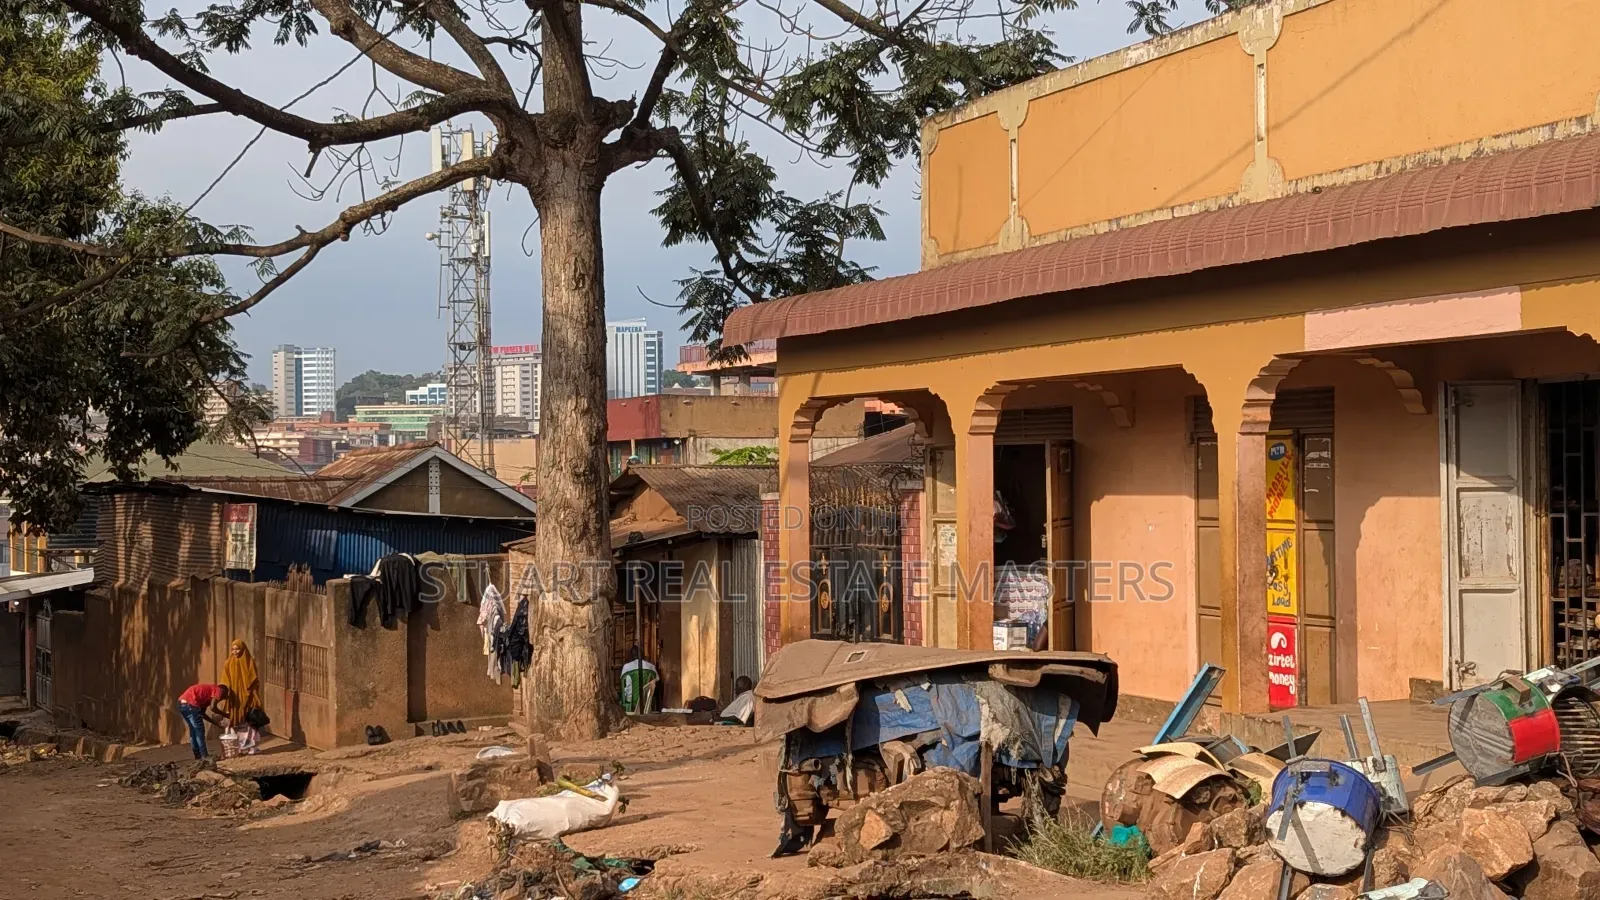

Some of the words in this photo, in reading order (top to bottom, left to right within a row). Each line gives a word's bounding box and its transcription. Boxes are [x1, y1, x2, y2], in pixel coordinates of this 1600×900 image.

[1270, 445, 1285, 456] MTN
[1266, 451, 1292, 504] MOBILE
[1268, 472, 1290, 519] MONEY
